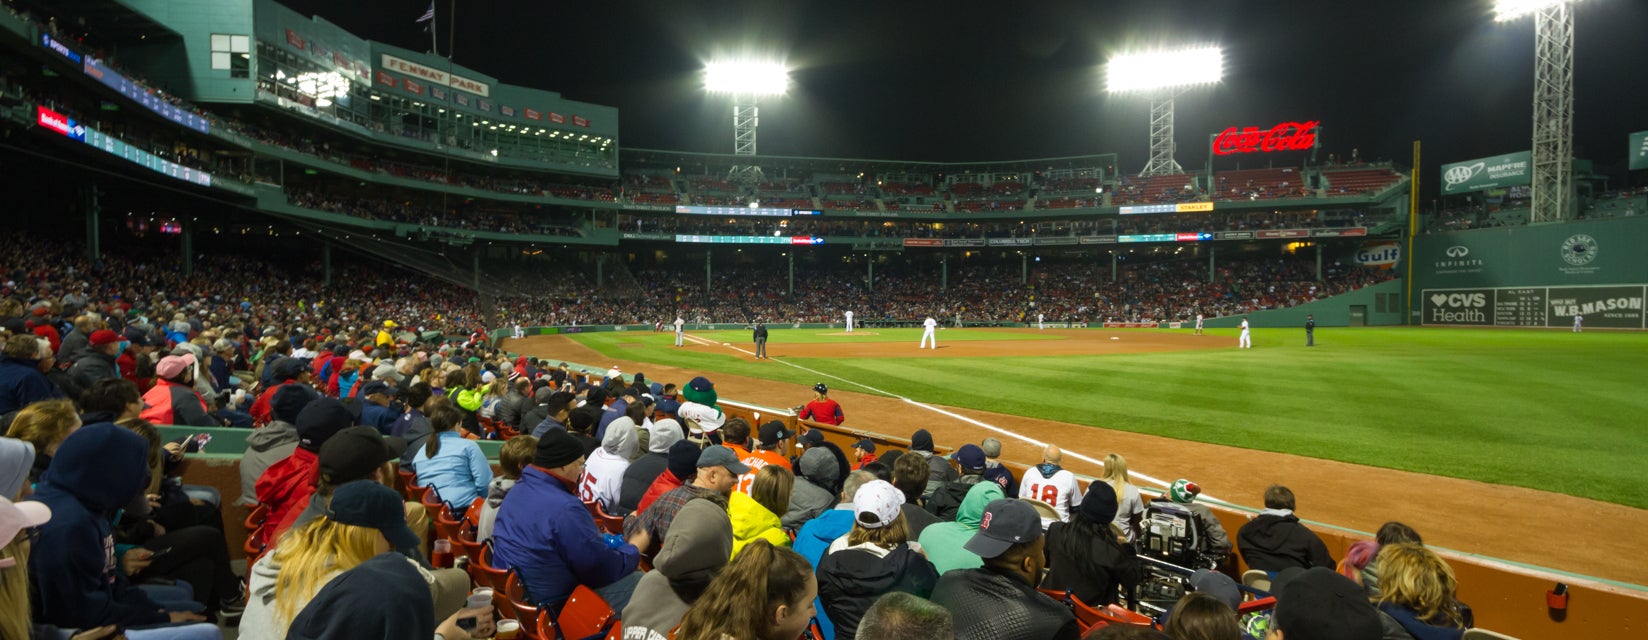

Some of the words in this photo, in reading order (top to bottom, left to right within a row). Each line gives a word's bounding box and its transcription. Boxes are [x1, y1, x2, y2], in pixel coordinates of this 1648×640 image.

[389, 59, 443, 81] FENWAY
[451, 76, 482, 93] PARK
[1212, 120, 1320, 155] Coca-Cola
[1487, 161, 1527, 172] MAPFRE
[1446, 167, 1471, 183] AAA
[1489, 170, 1525, 179] INSURANCE
[1357, 248, 1398, 262] Gulf
[1435, 259, 1483, 268] INFINITI
[1448, 293, 1486, 308] CVS
[1432, 308, 1486, 322] Health
[737, 473, 756, 497] 13
[1031, 484, 1058, 507] 18
[624, 626, 648, 640] UPPER
